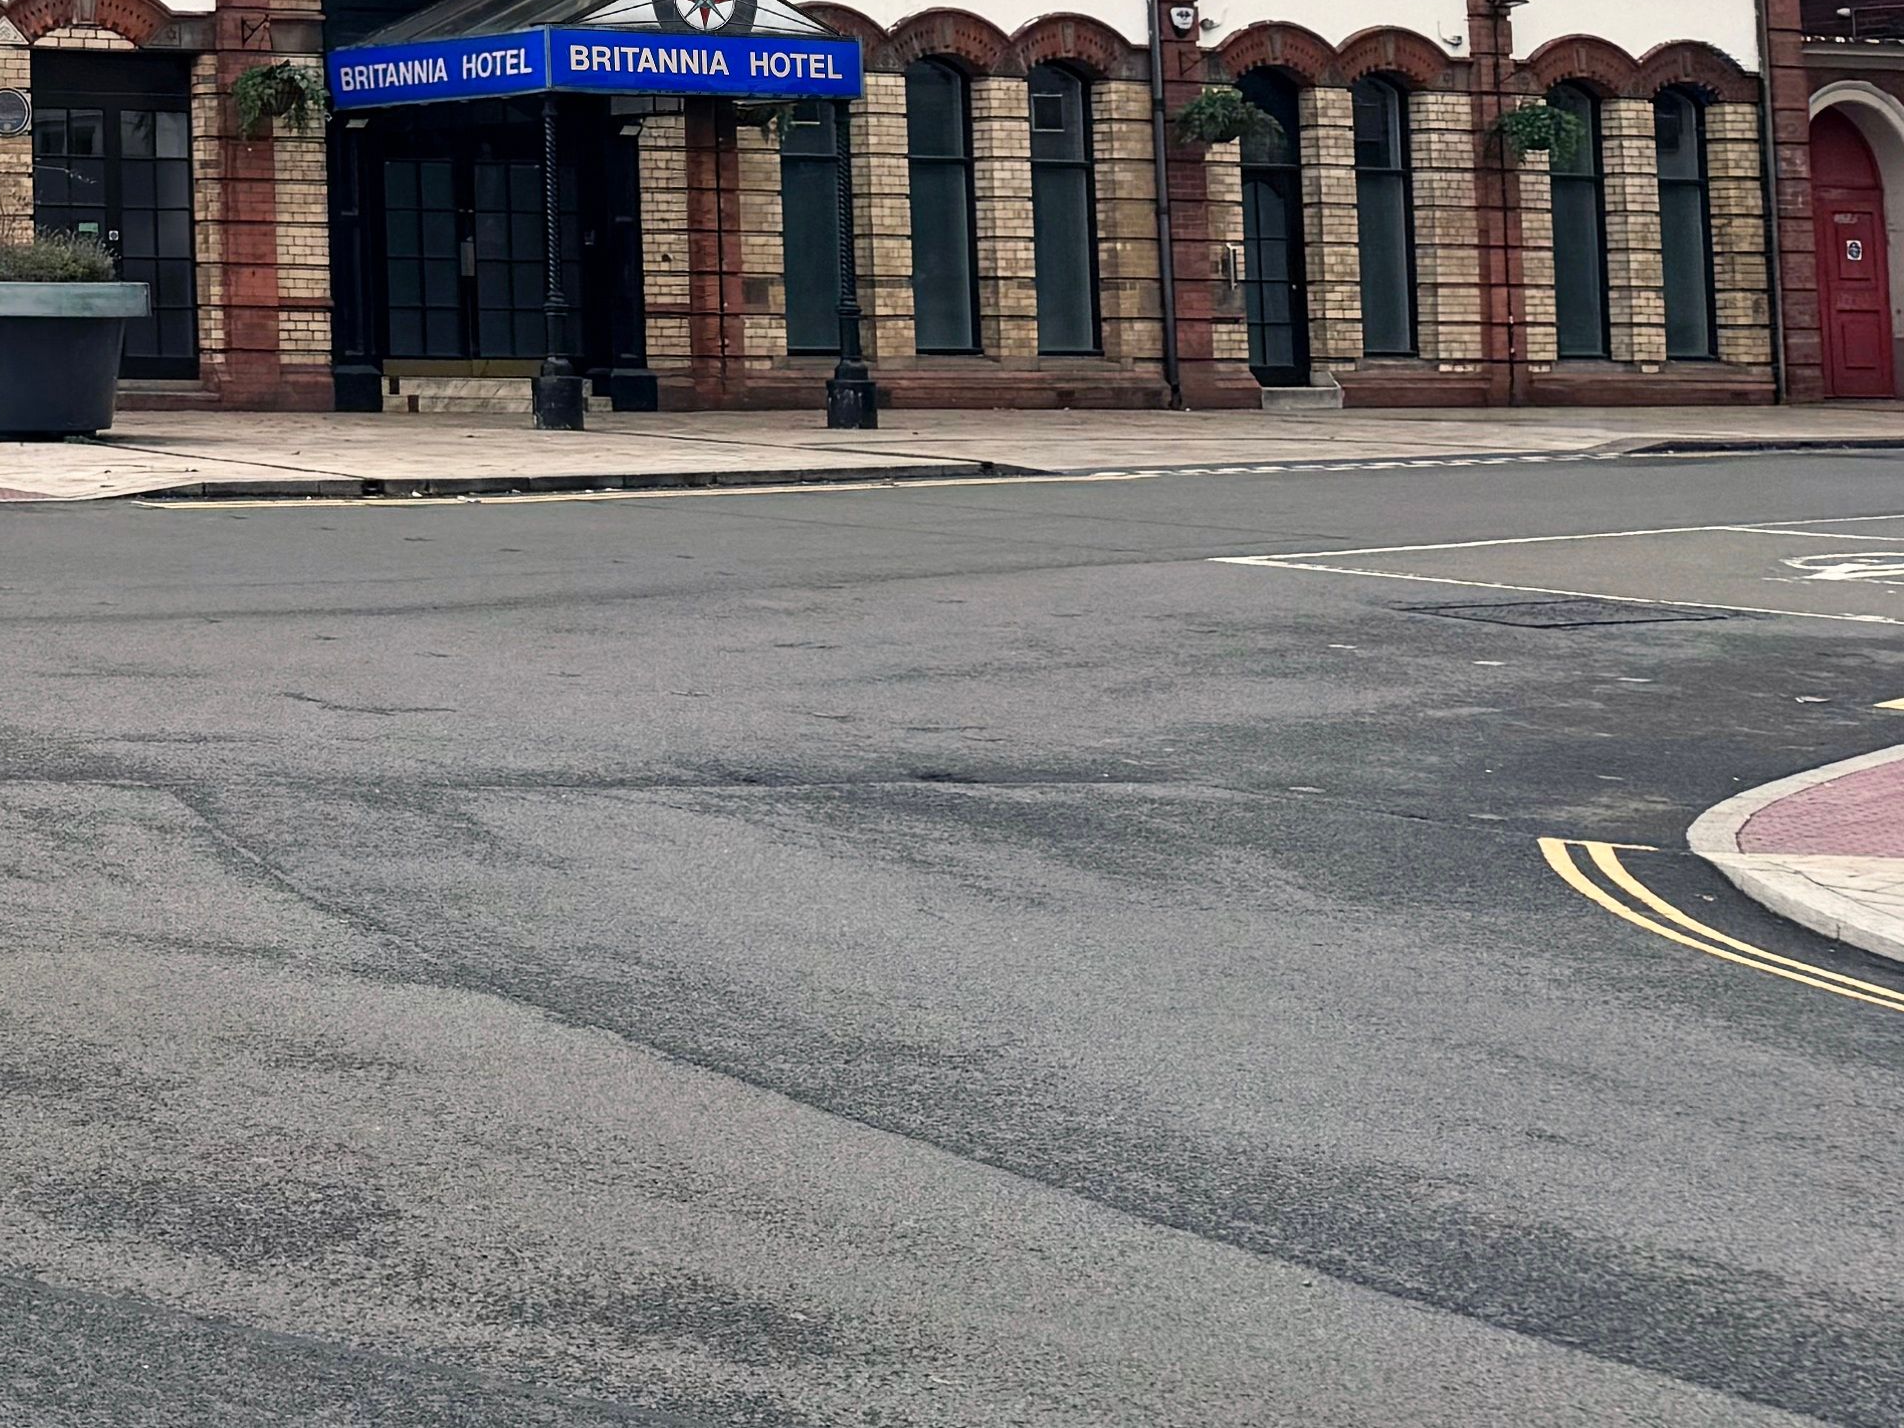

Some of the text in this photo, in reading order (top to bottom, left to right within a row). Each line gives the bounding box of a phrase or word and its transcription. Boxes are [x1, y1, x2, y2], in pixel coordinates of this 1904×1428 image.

[340, 47, 533, 91] BRITANNIA HOTEL
[569, 44, 843, 79] BRITANNIA HOTEL
